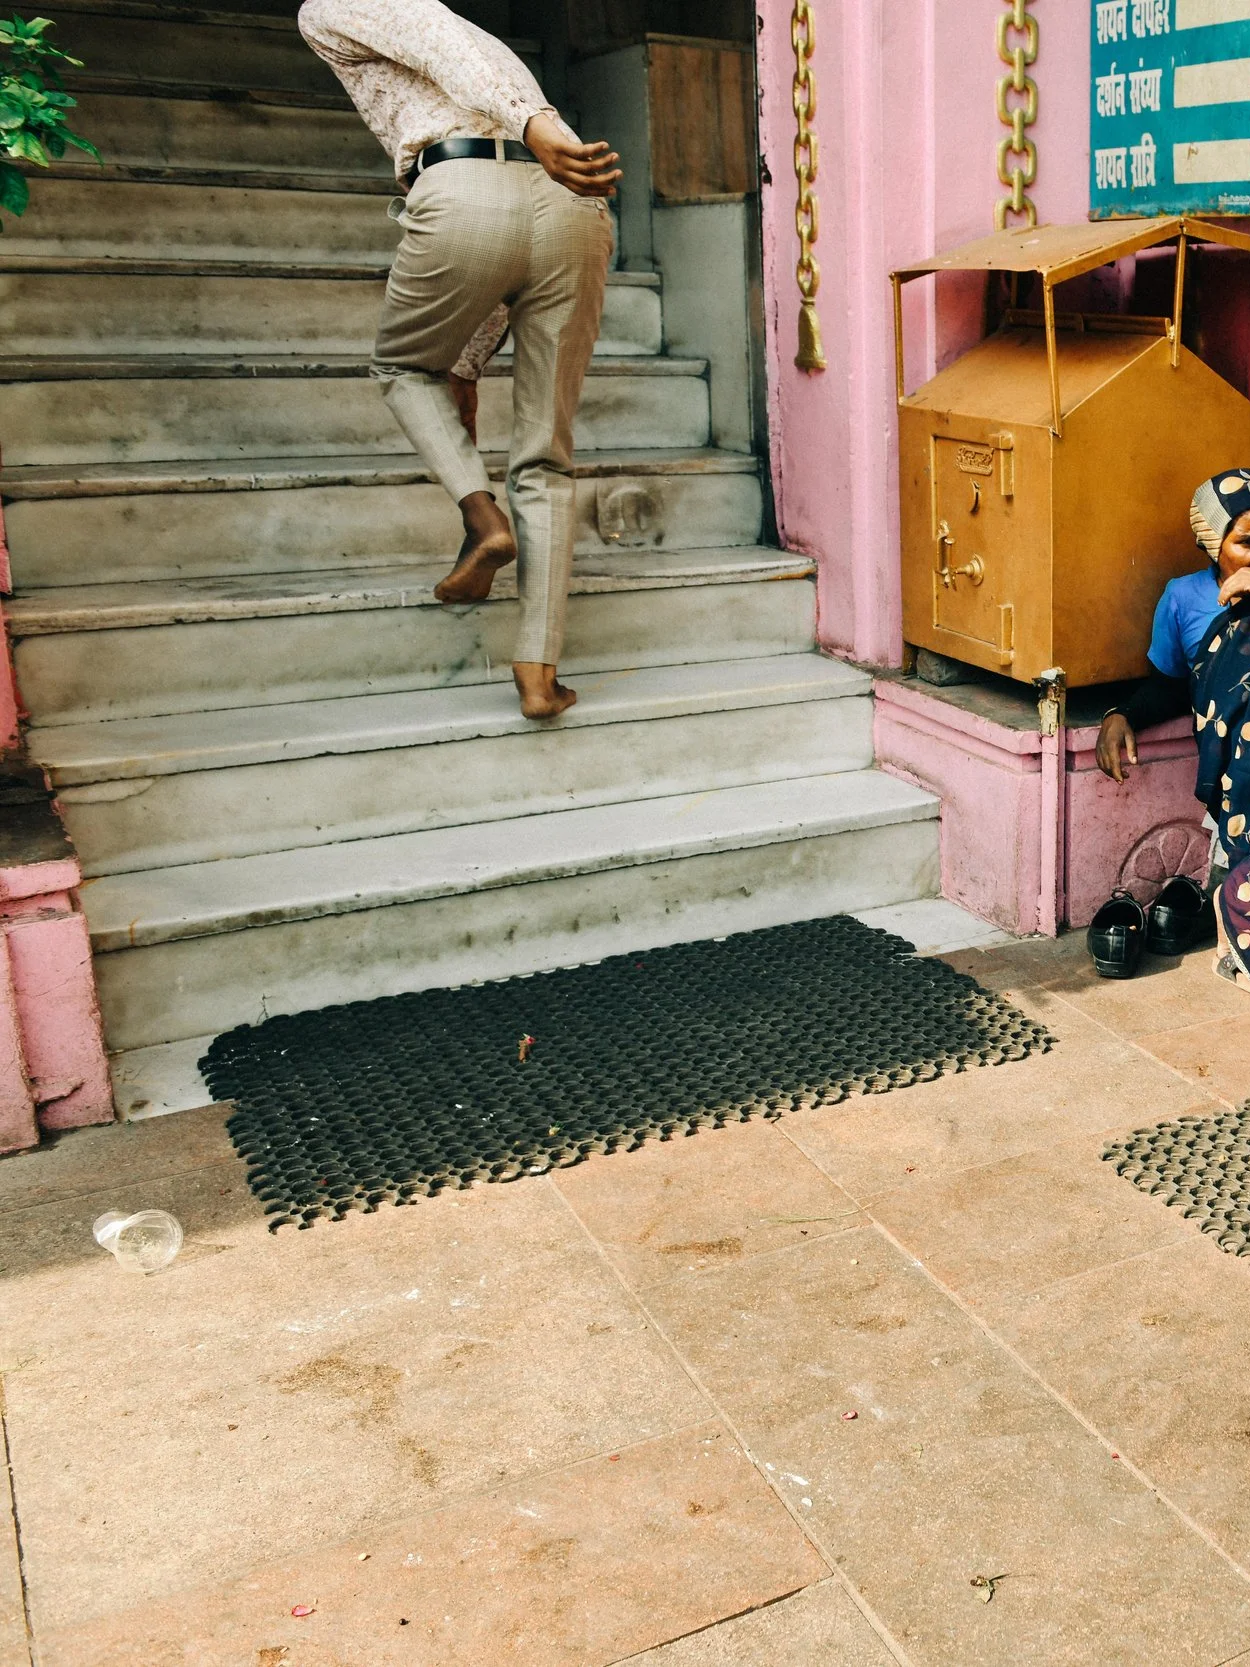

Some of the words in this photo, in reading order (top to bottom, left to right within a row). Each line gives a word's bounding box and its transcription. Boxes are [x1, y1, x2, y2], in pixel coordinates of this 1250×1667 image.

[1096, 0, 1128, 44] शयन
[1096, 61, 1126, 117] दर्शन
[1095, 147, 1127, 189] शयन
[1129, 132, 1157, 187] रात्रि
